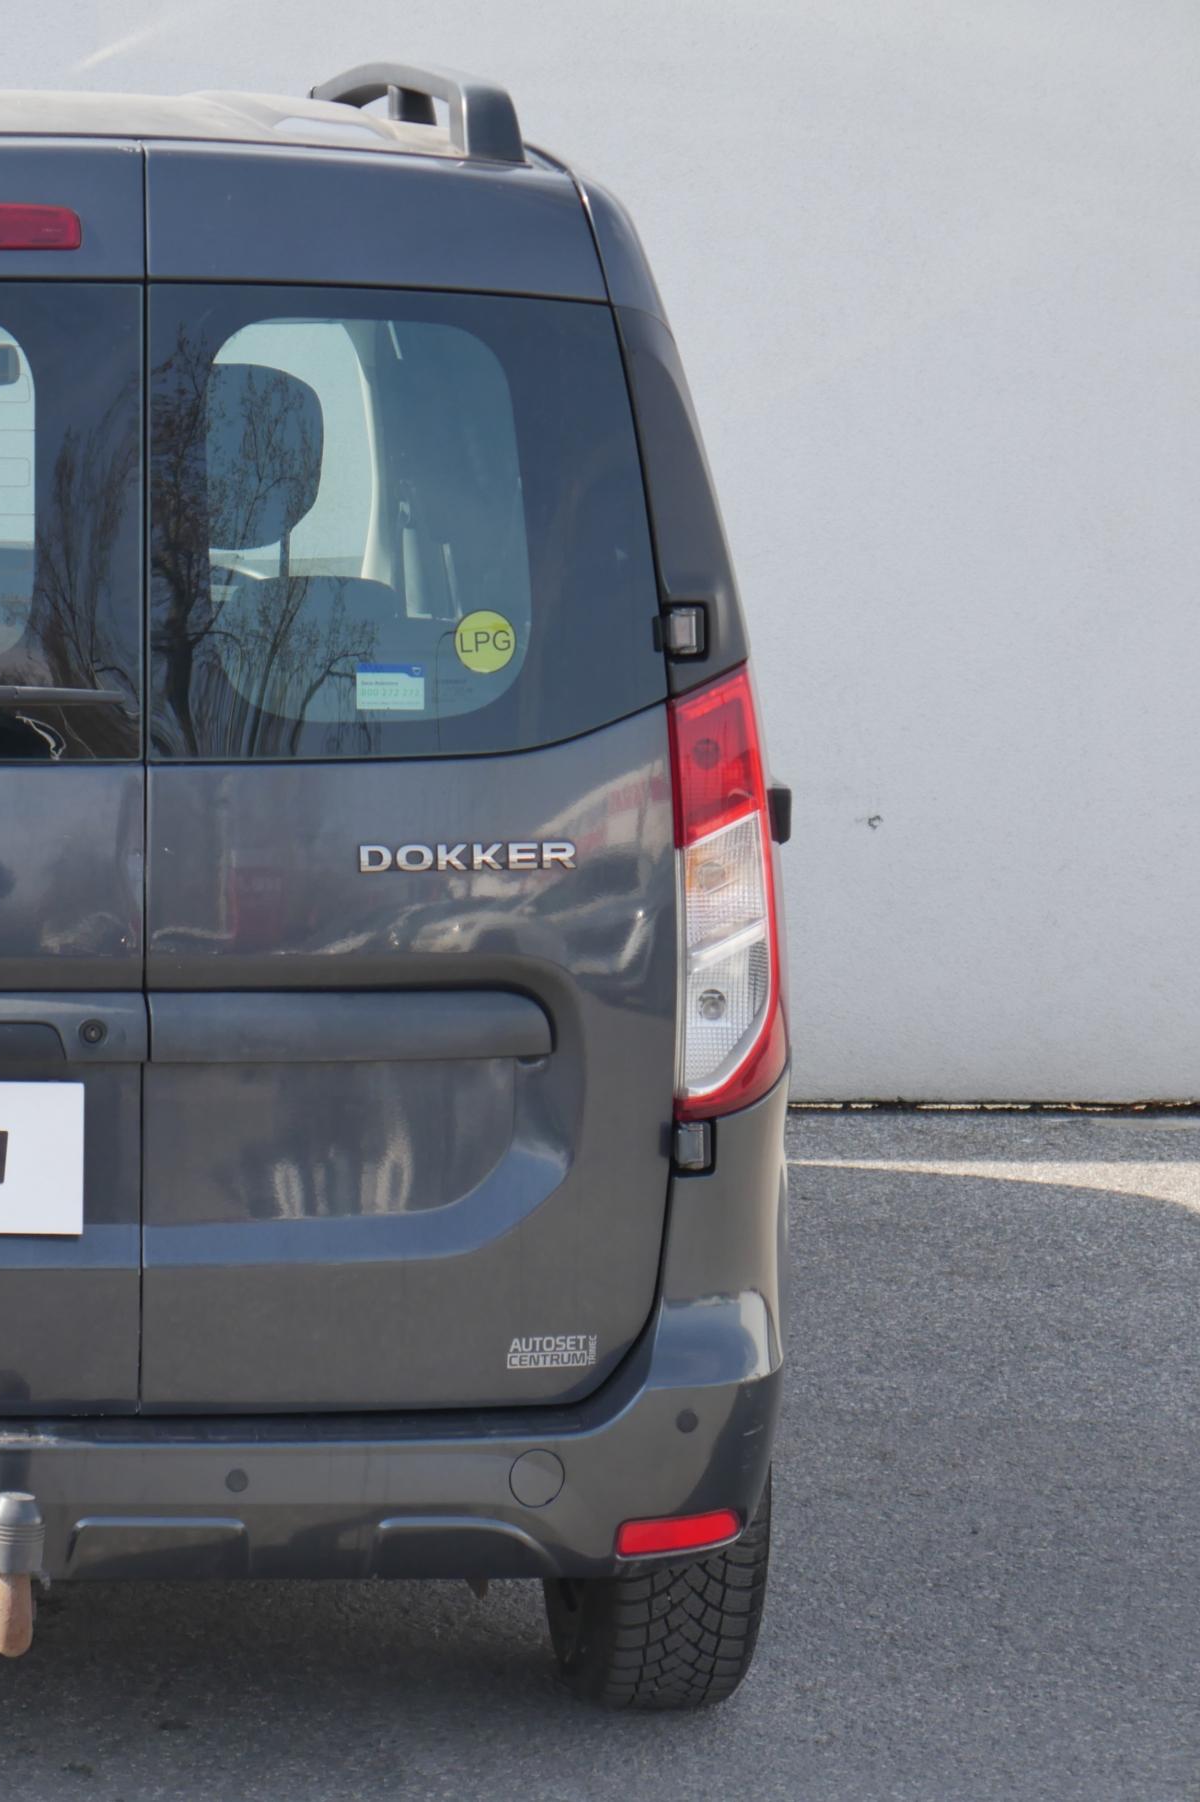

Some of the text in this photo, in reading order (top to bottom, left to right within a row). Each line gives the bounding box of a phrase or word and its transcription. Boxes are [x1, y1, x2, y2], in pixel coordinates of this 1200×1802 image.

[459, 630, 512, 653] LPG
[358, 841, 577, 873] DOKKER
[509, 1335, 587, 1353] AUTOSET
[508, 1352, 586, 1367] CENTRUM
